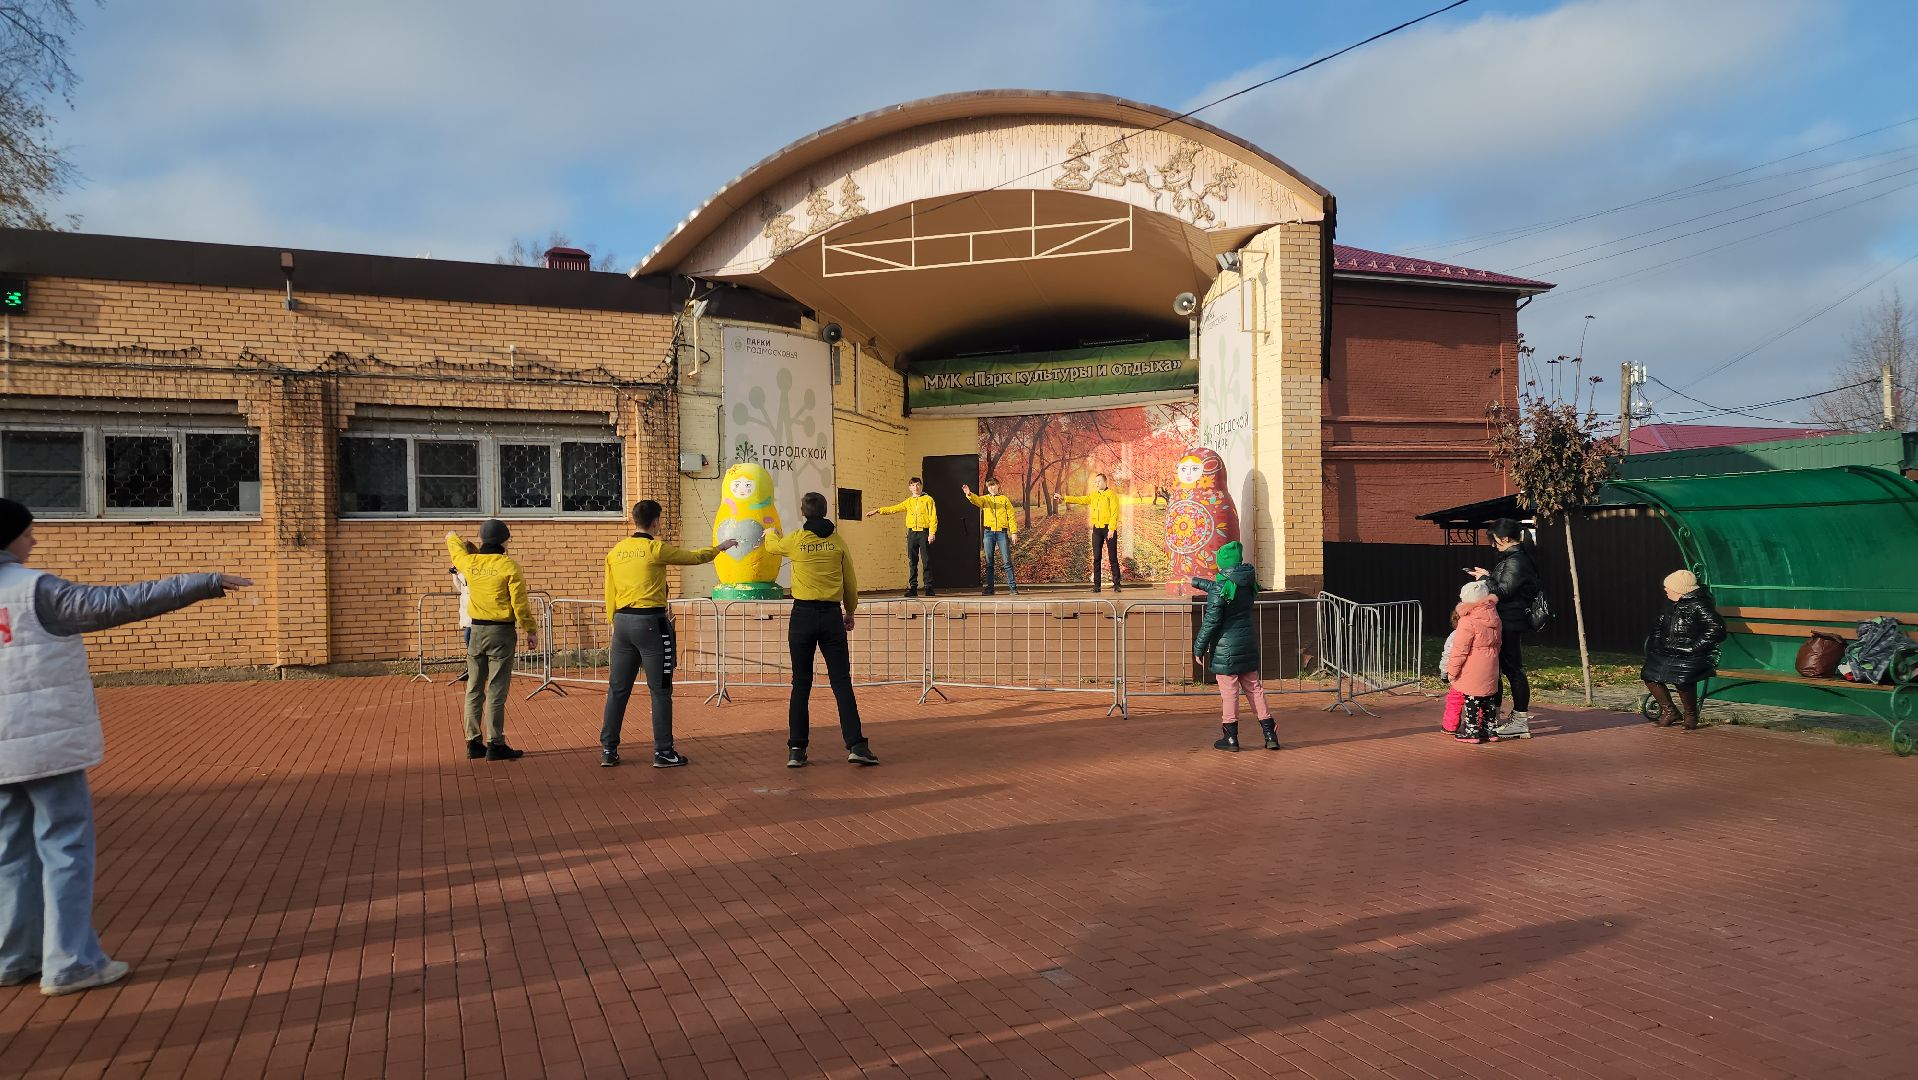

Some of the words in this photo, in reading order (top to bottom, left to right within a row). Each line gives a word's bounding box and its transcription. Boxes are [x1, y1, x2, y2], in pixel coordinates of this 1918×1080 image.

[746, 337, 771, 347] ПАРКИ
[924, 374, 961, 390] МУК
[965, 371, 1012, 388] «Парк
[1016, 365, 1092, 386] культуры
[1097, 364, 1107, 376] и
[1111, 359, 1182, 376] отдыха»
[762, 444, 827, 460] ГОРОДСКОЙ
[762, 458, 794, 471] ПАРК
